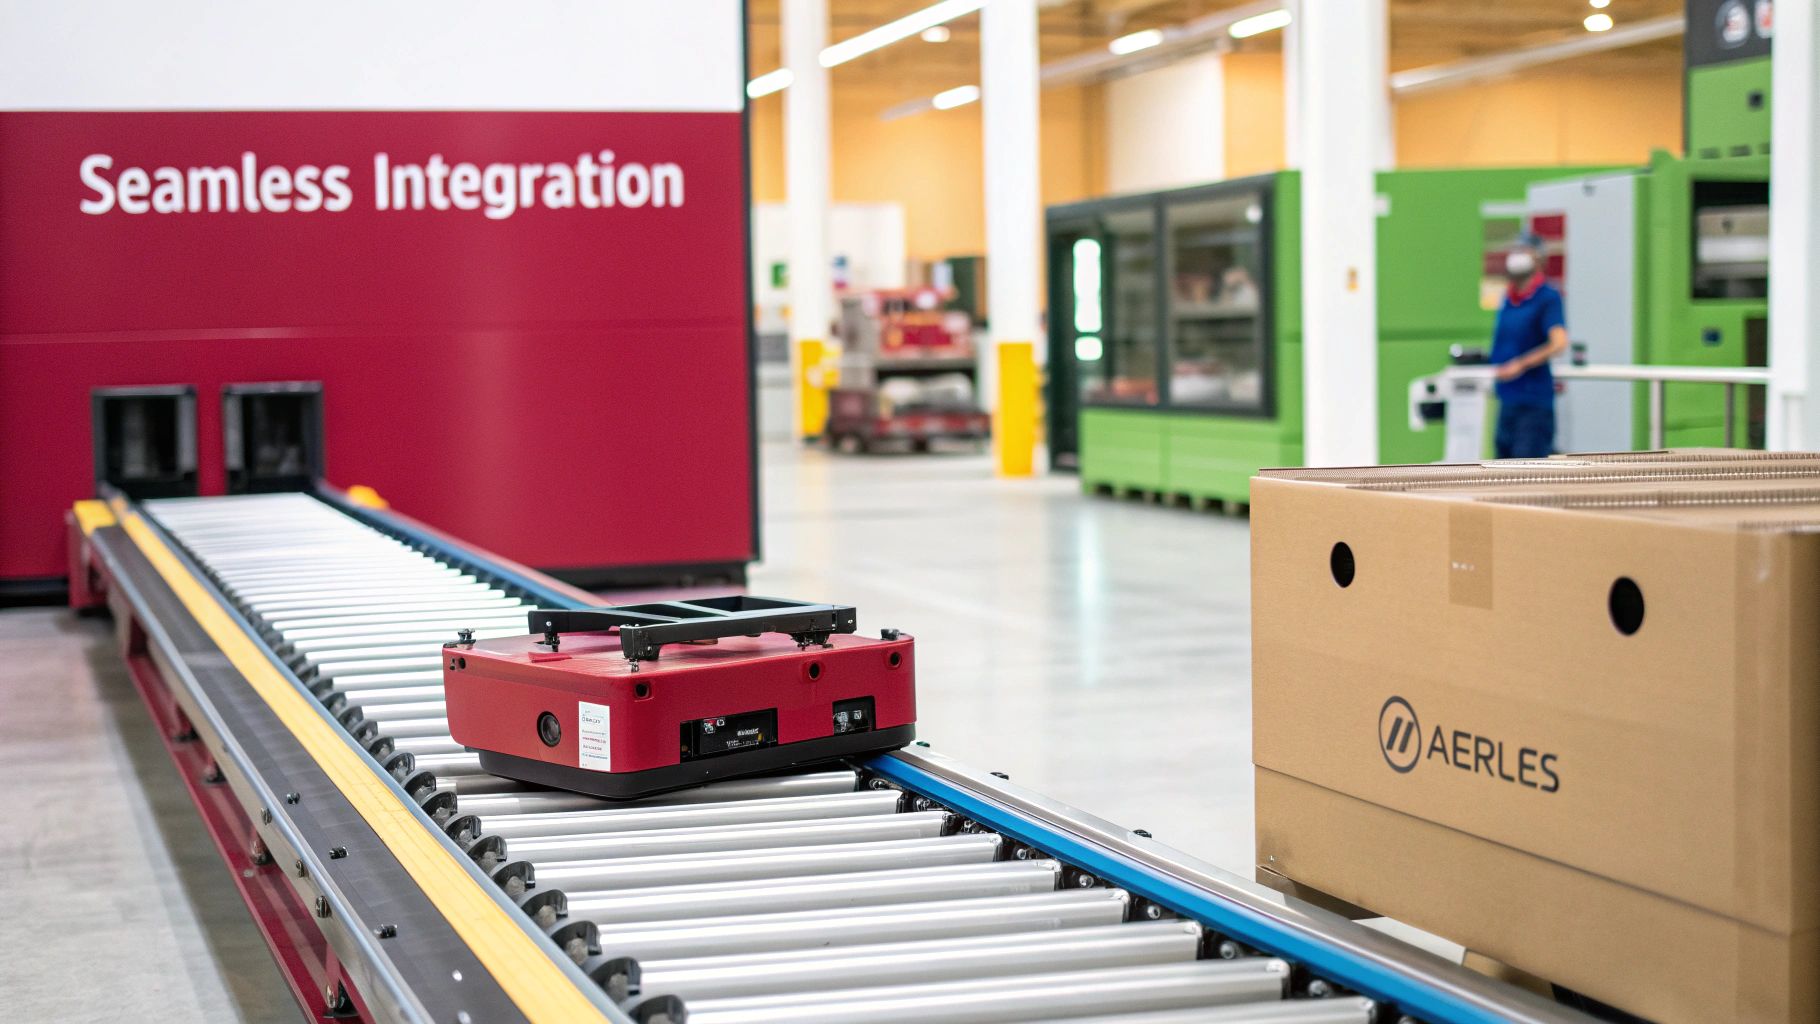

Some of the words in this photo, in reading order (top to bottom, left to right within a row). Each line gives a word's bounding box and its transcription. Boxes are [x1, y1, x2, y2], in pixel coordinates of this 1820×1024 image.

[79, 152, 353, 215] Seamless
[374, 149, 685, 220] Integration
[1426, 725, 1560, 793] AERLES
